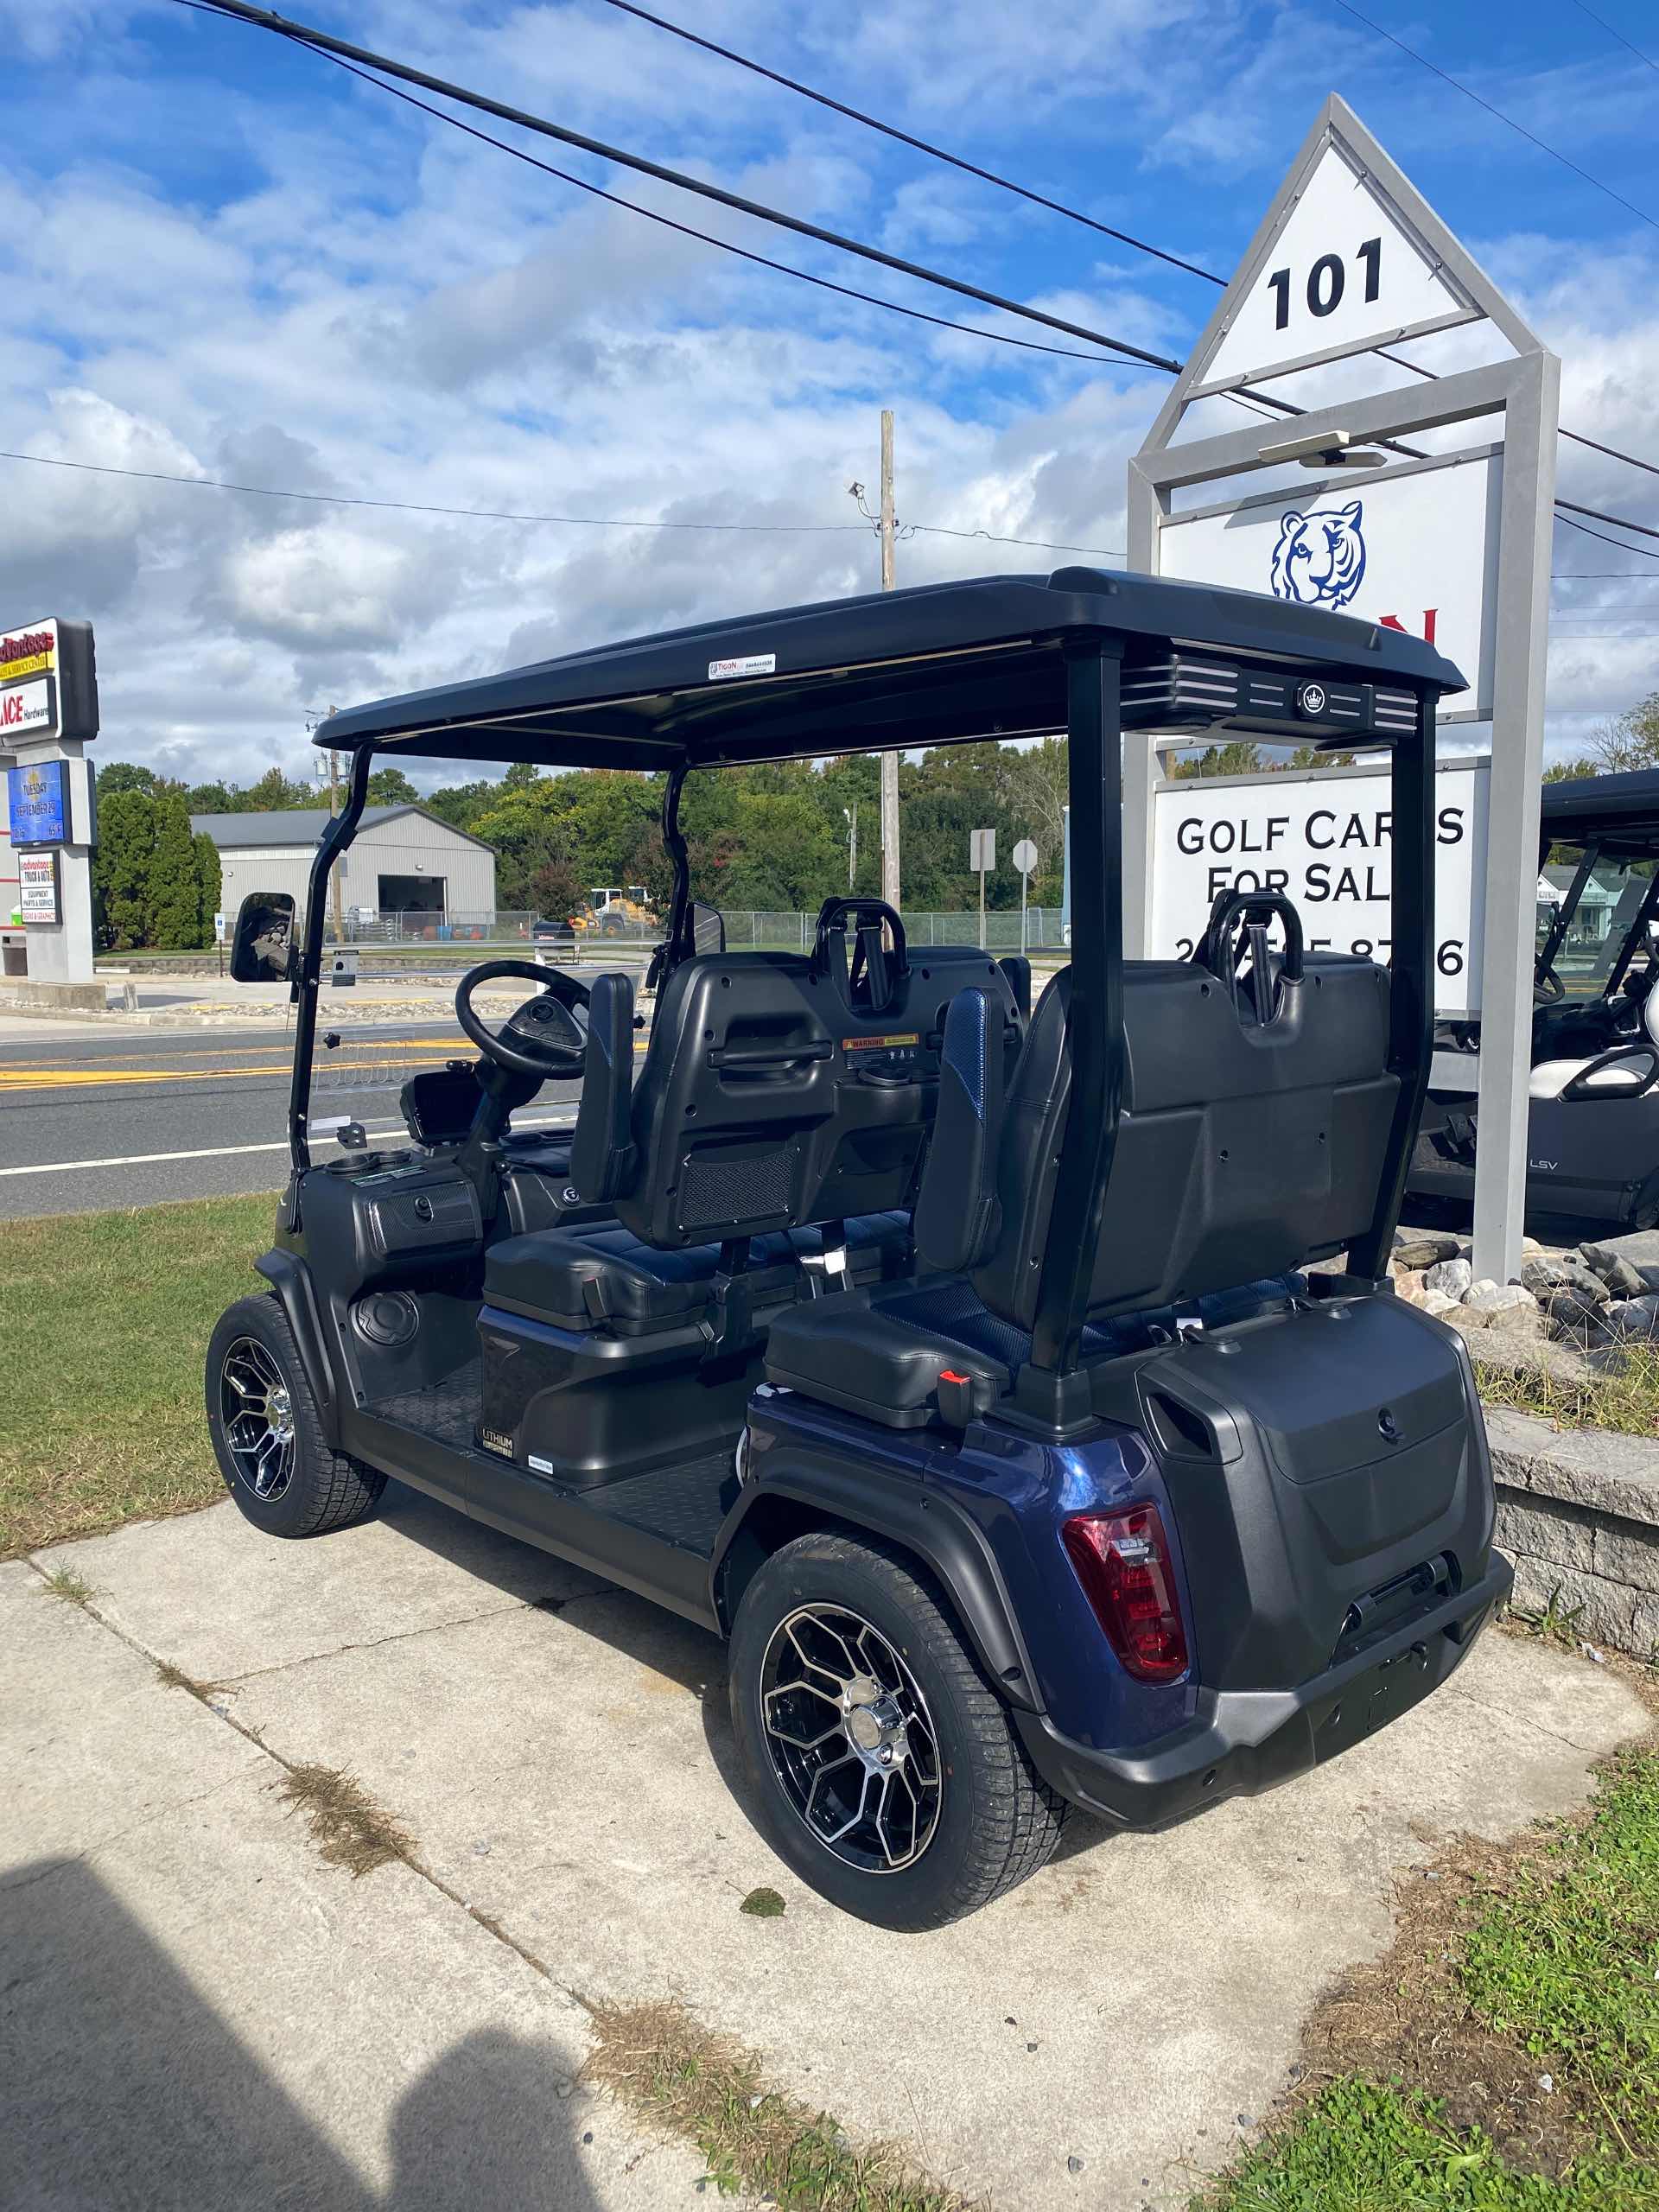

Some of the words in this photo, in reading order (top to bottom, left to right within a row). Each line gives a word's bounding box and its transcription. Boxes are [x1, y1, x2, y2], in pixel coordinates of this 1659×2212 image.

[1268, 237, 1381, 330] 101
[24, 707, 49, 720] Hardware
[23, 782, 48, 795] TUESDAY
[16, 803, 48, 817] SEPTEMBER
[1177, 816, 1290, 855] GOLF
[1305, 807, 1465, 850] CARS
[1207, 866, 1289, 904] FOR
[1304, 863, 1392, 903] SAL
[852, 1038, 884, 1047] WARNING
[1529, 1159, 1558, 1170] LSV
[482, 1428, 512, 1449] LITHIUM
